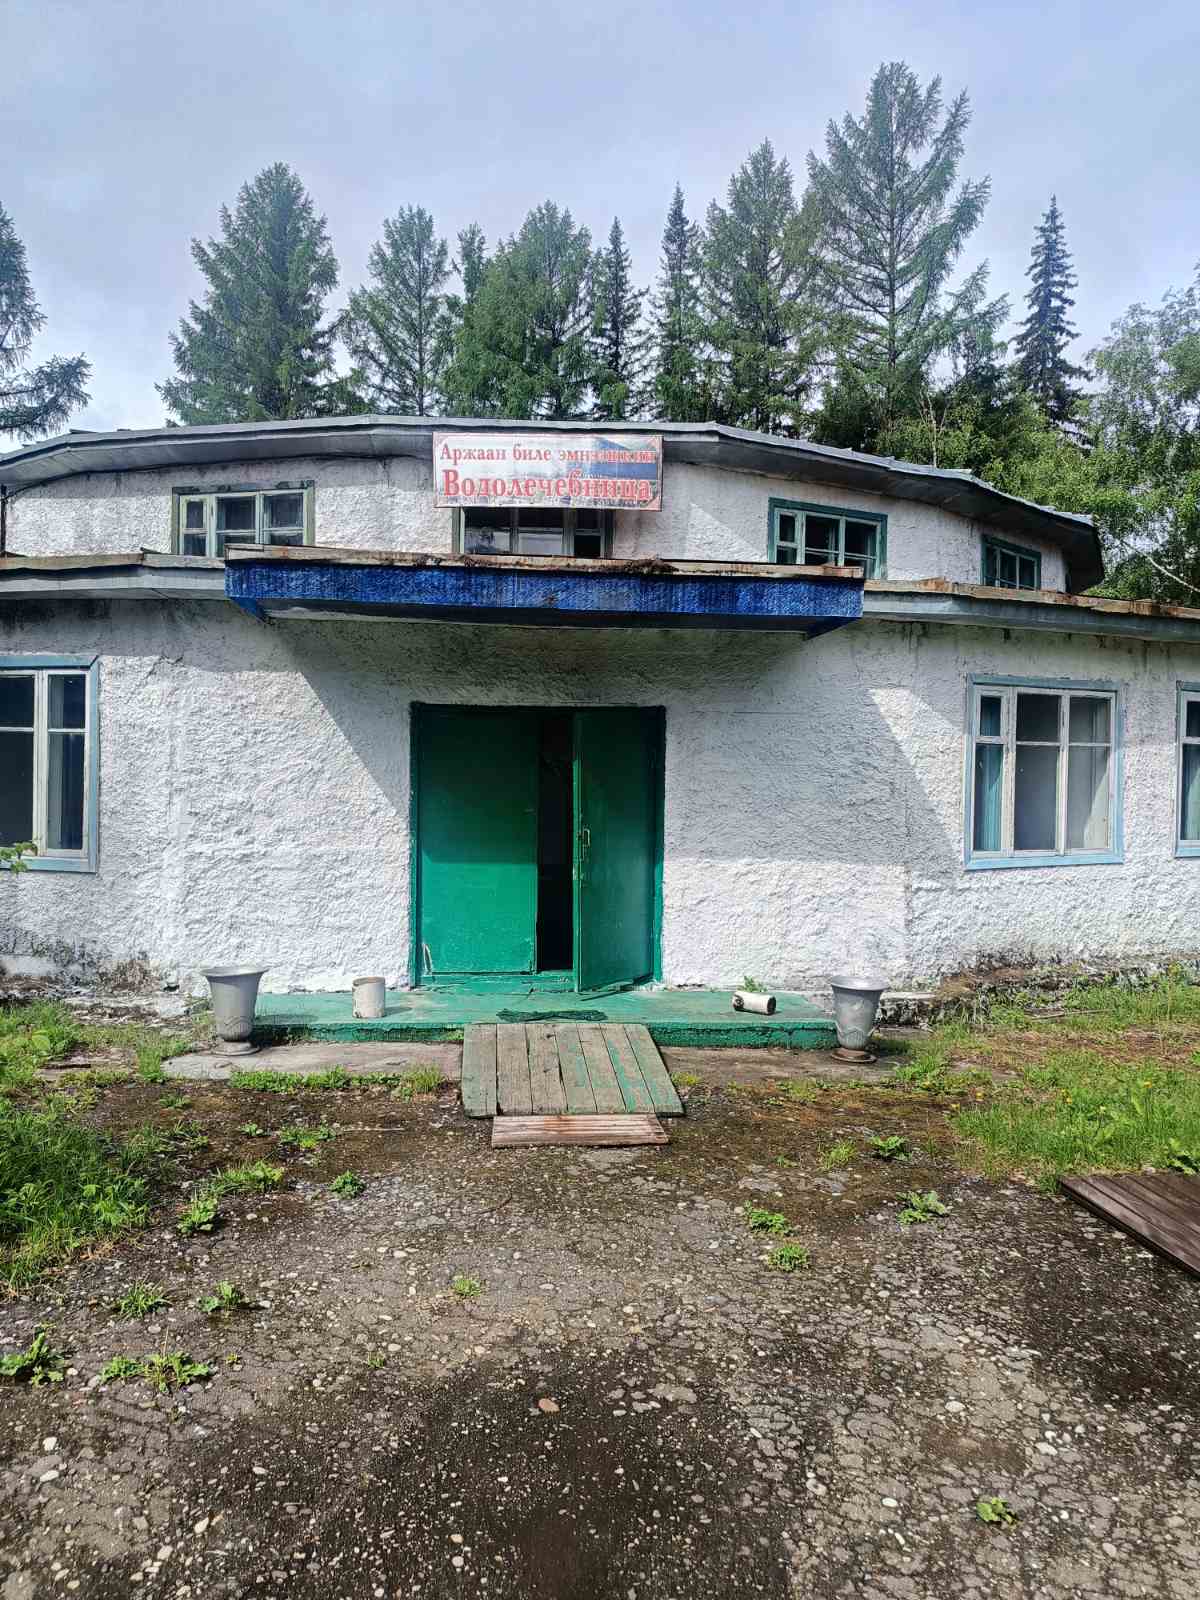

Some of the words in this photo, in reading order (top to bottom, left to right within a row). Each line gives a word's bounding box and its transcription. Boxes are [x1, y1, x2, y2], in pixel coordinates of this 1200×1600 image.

[440, 443, 506, 465] Аржаан
[512, 443, 552, 461] биле
[442, 469, 652, 500] Водолечебница
